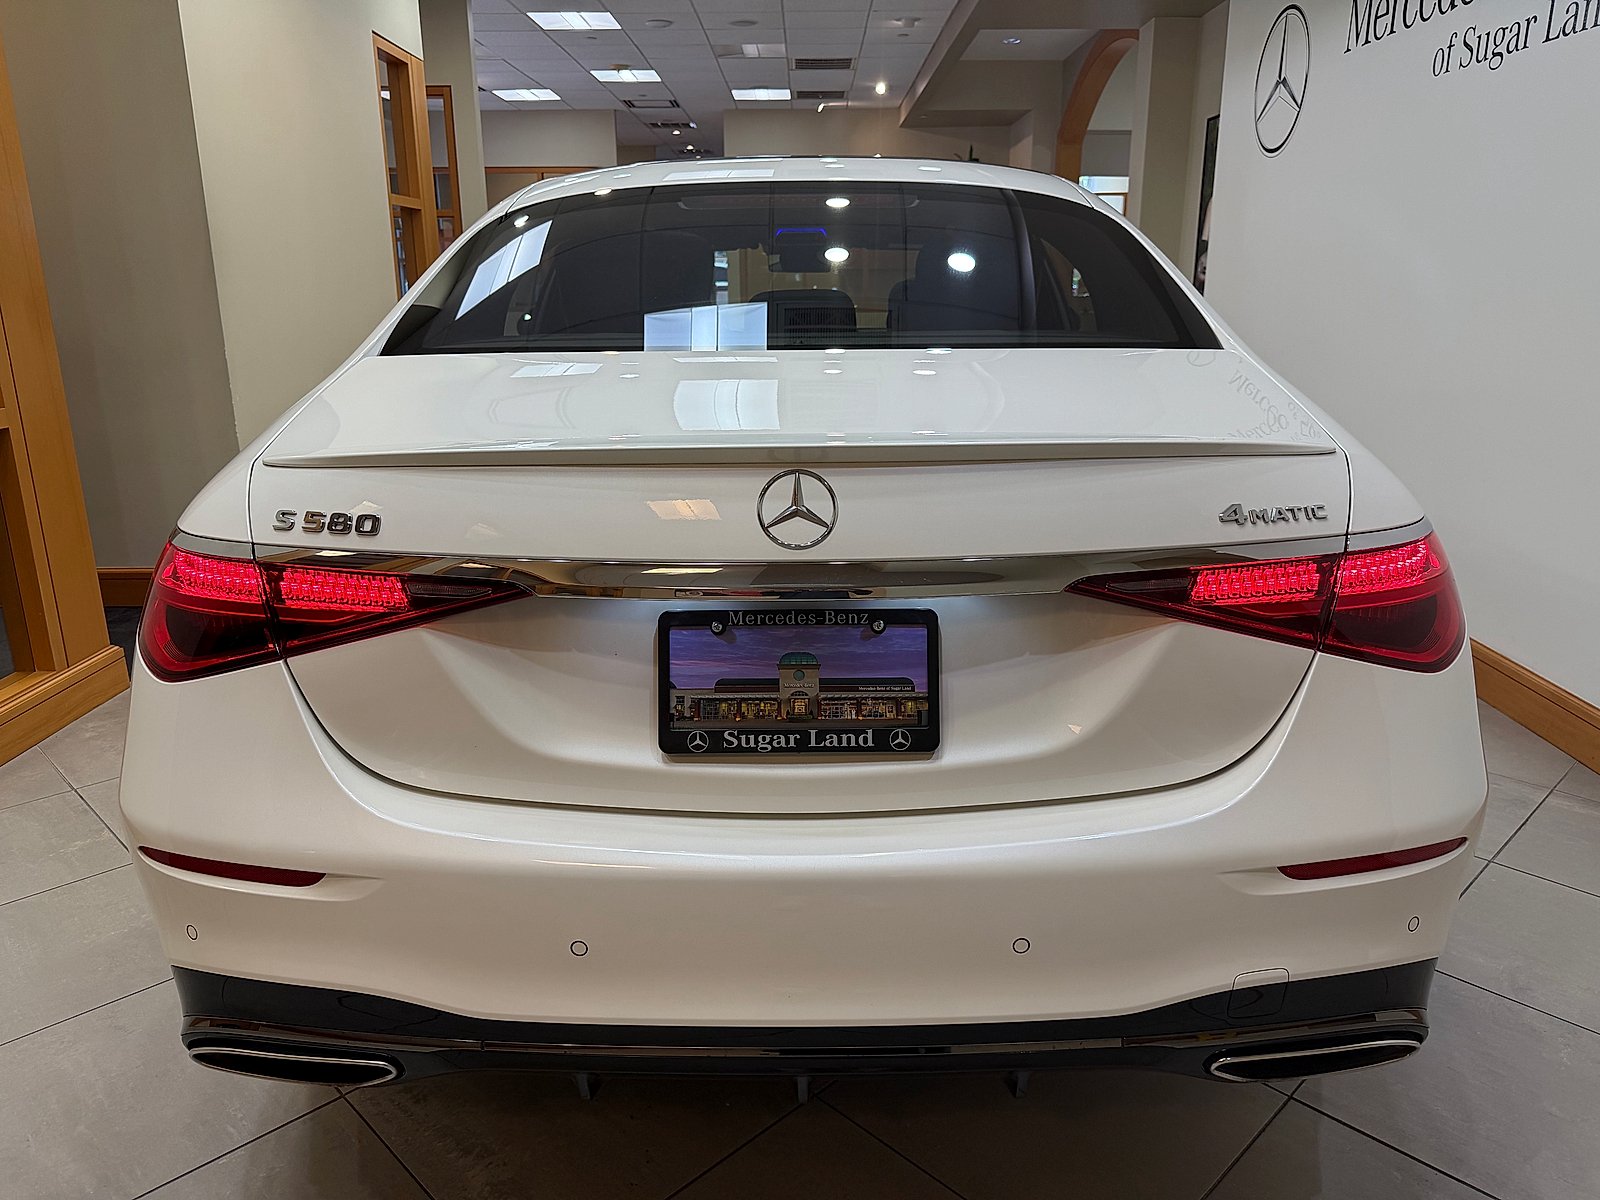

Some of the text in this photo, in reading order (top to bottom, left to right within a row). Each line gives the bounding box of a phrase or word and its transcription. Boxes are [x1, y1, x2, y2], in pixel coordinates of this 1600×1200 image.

[1432, 31, 1458, 77] of
[1458, 14, 1537, 71] Sugar
[272, 509, 381, 536] S 580
[1218, 503, 1328, 525] 4MATIC
[728, 610, 869, 626] Mercedes-Benz
[723, 729, 875, 752] Sugar Land
